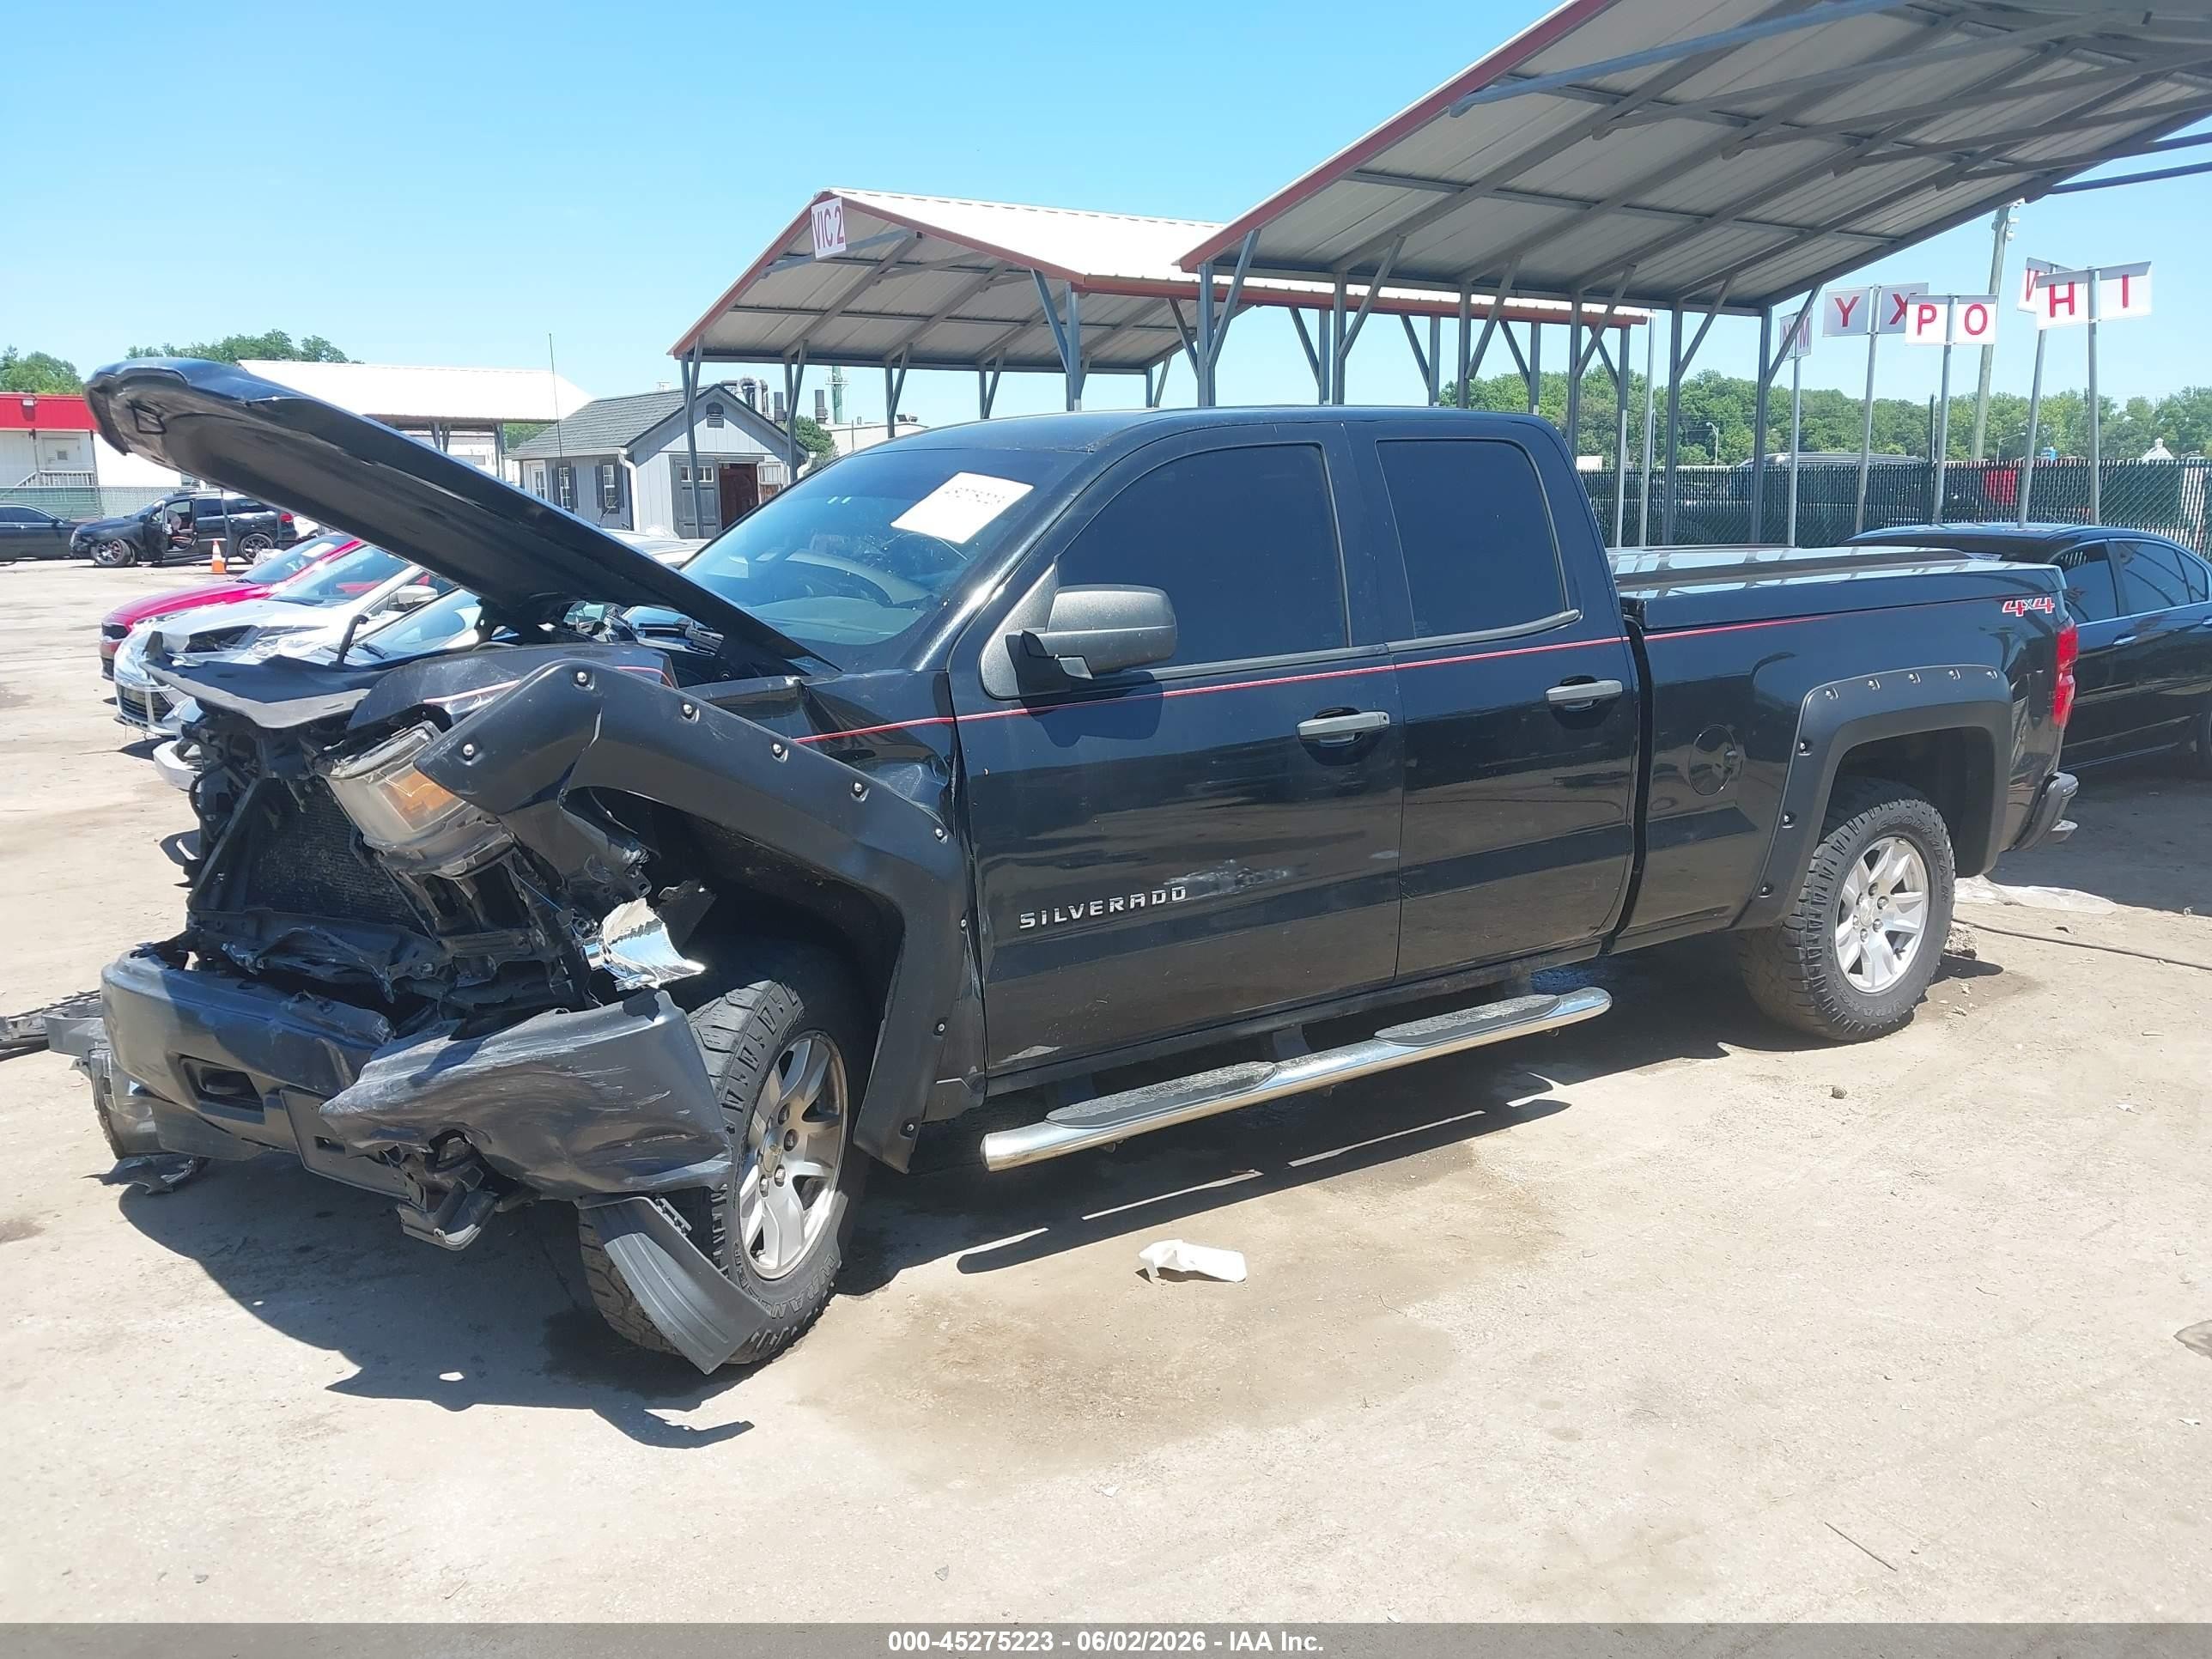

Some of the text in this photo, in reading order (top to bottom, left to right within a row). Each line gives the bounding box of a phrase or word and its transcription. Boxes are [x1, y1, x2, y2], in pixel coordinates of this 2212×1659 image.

[812, 205, 845, 250] VIC 2
[1833, 292, 1917, 328] Y X
[2049, 274, 2130, 318] H I
[1917, 303, 1988, 337] P O
[1018, 885, 1188, 930] SILVERADO
